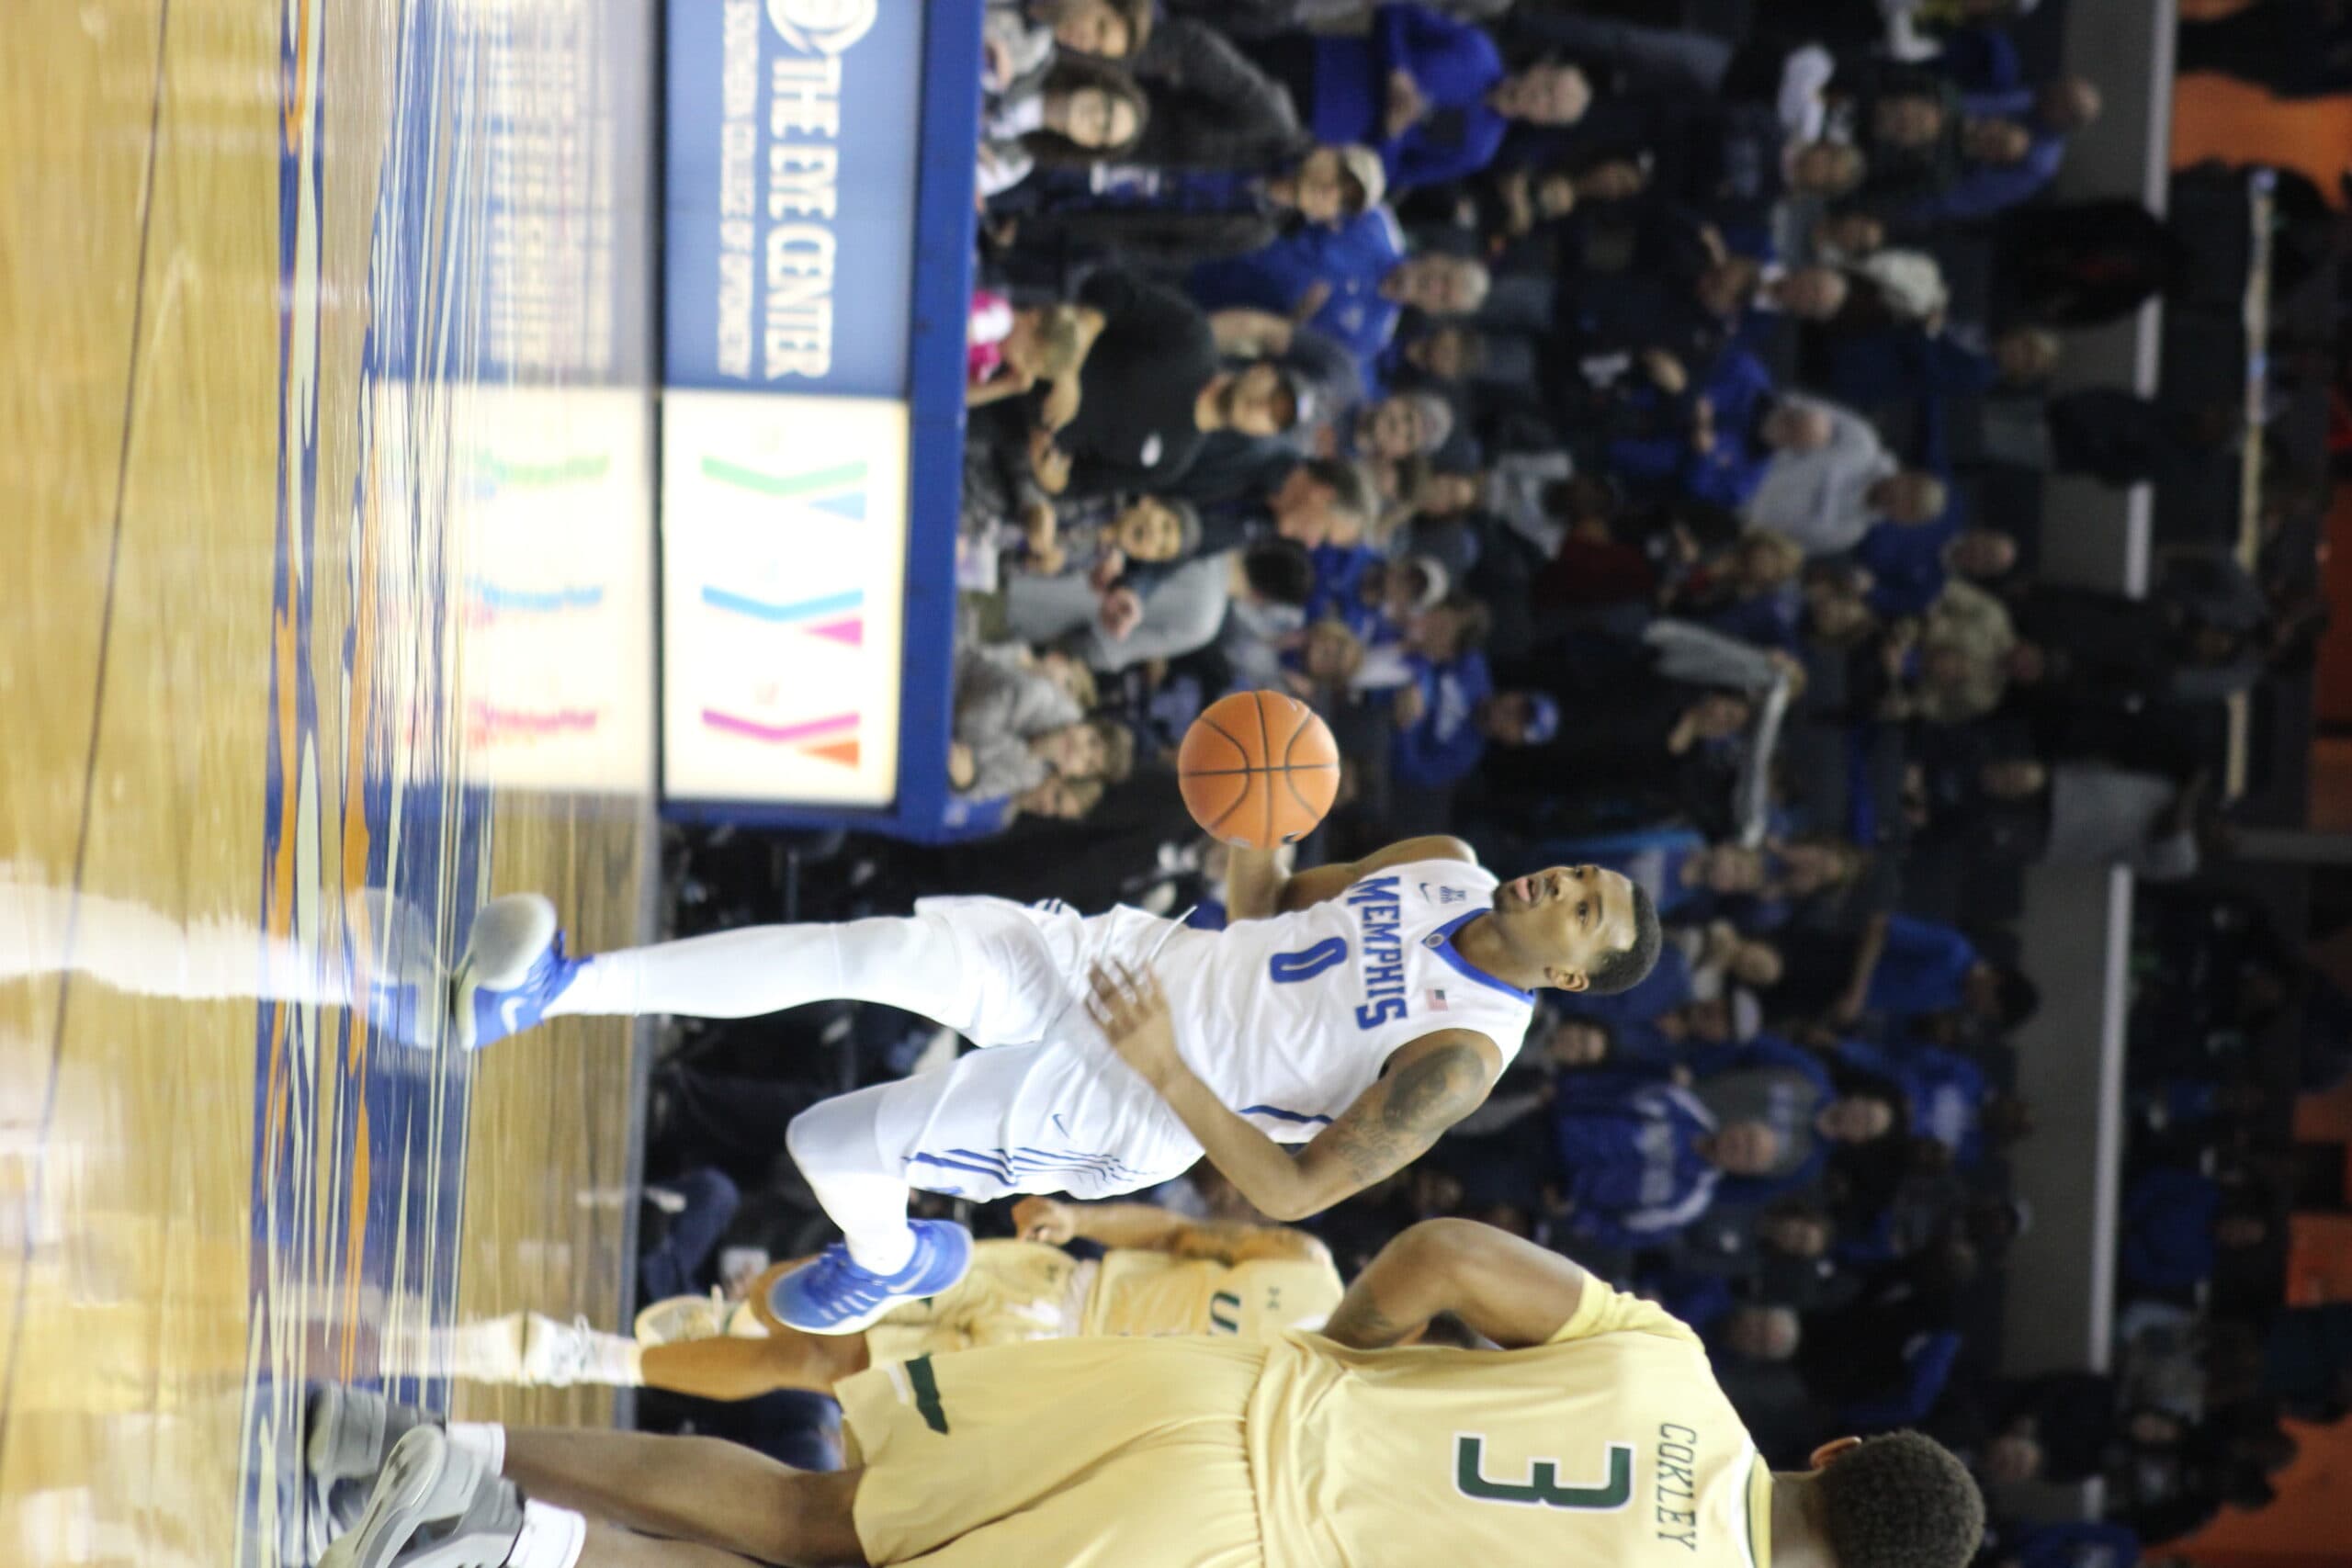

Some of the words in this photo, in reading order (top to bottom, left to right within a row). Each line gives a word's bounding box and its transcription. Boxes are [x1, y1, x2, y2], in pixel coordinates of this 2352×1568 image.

[770, 55, 842, 140] THE
[768, 143, 838, 221] EYE
[764, 222, 837, 382] CENTER
[1269, 936, 1349, 984] 0
[1347, 875, 1409, 1031] MEMPHIS
[1452, 1430, 1636, 1513] 3
[1656, 1422, 1699, 1551] COKLEY
